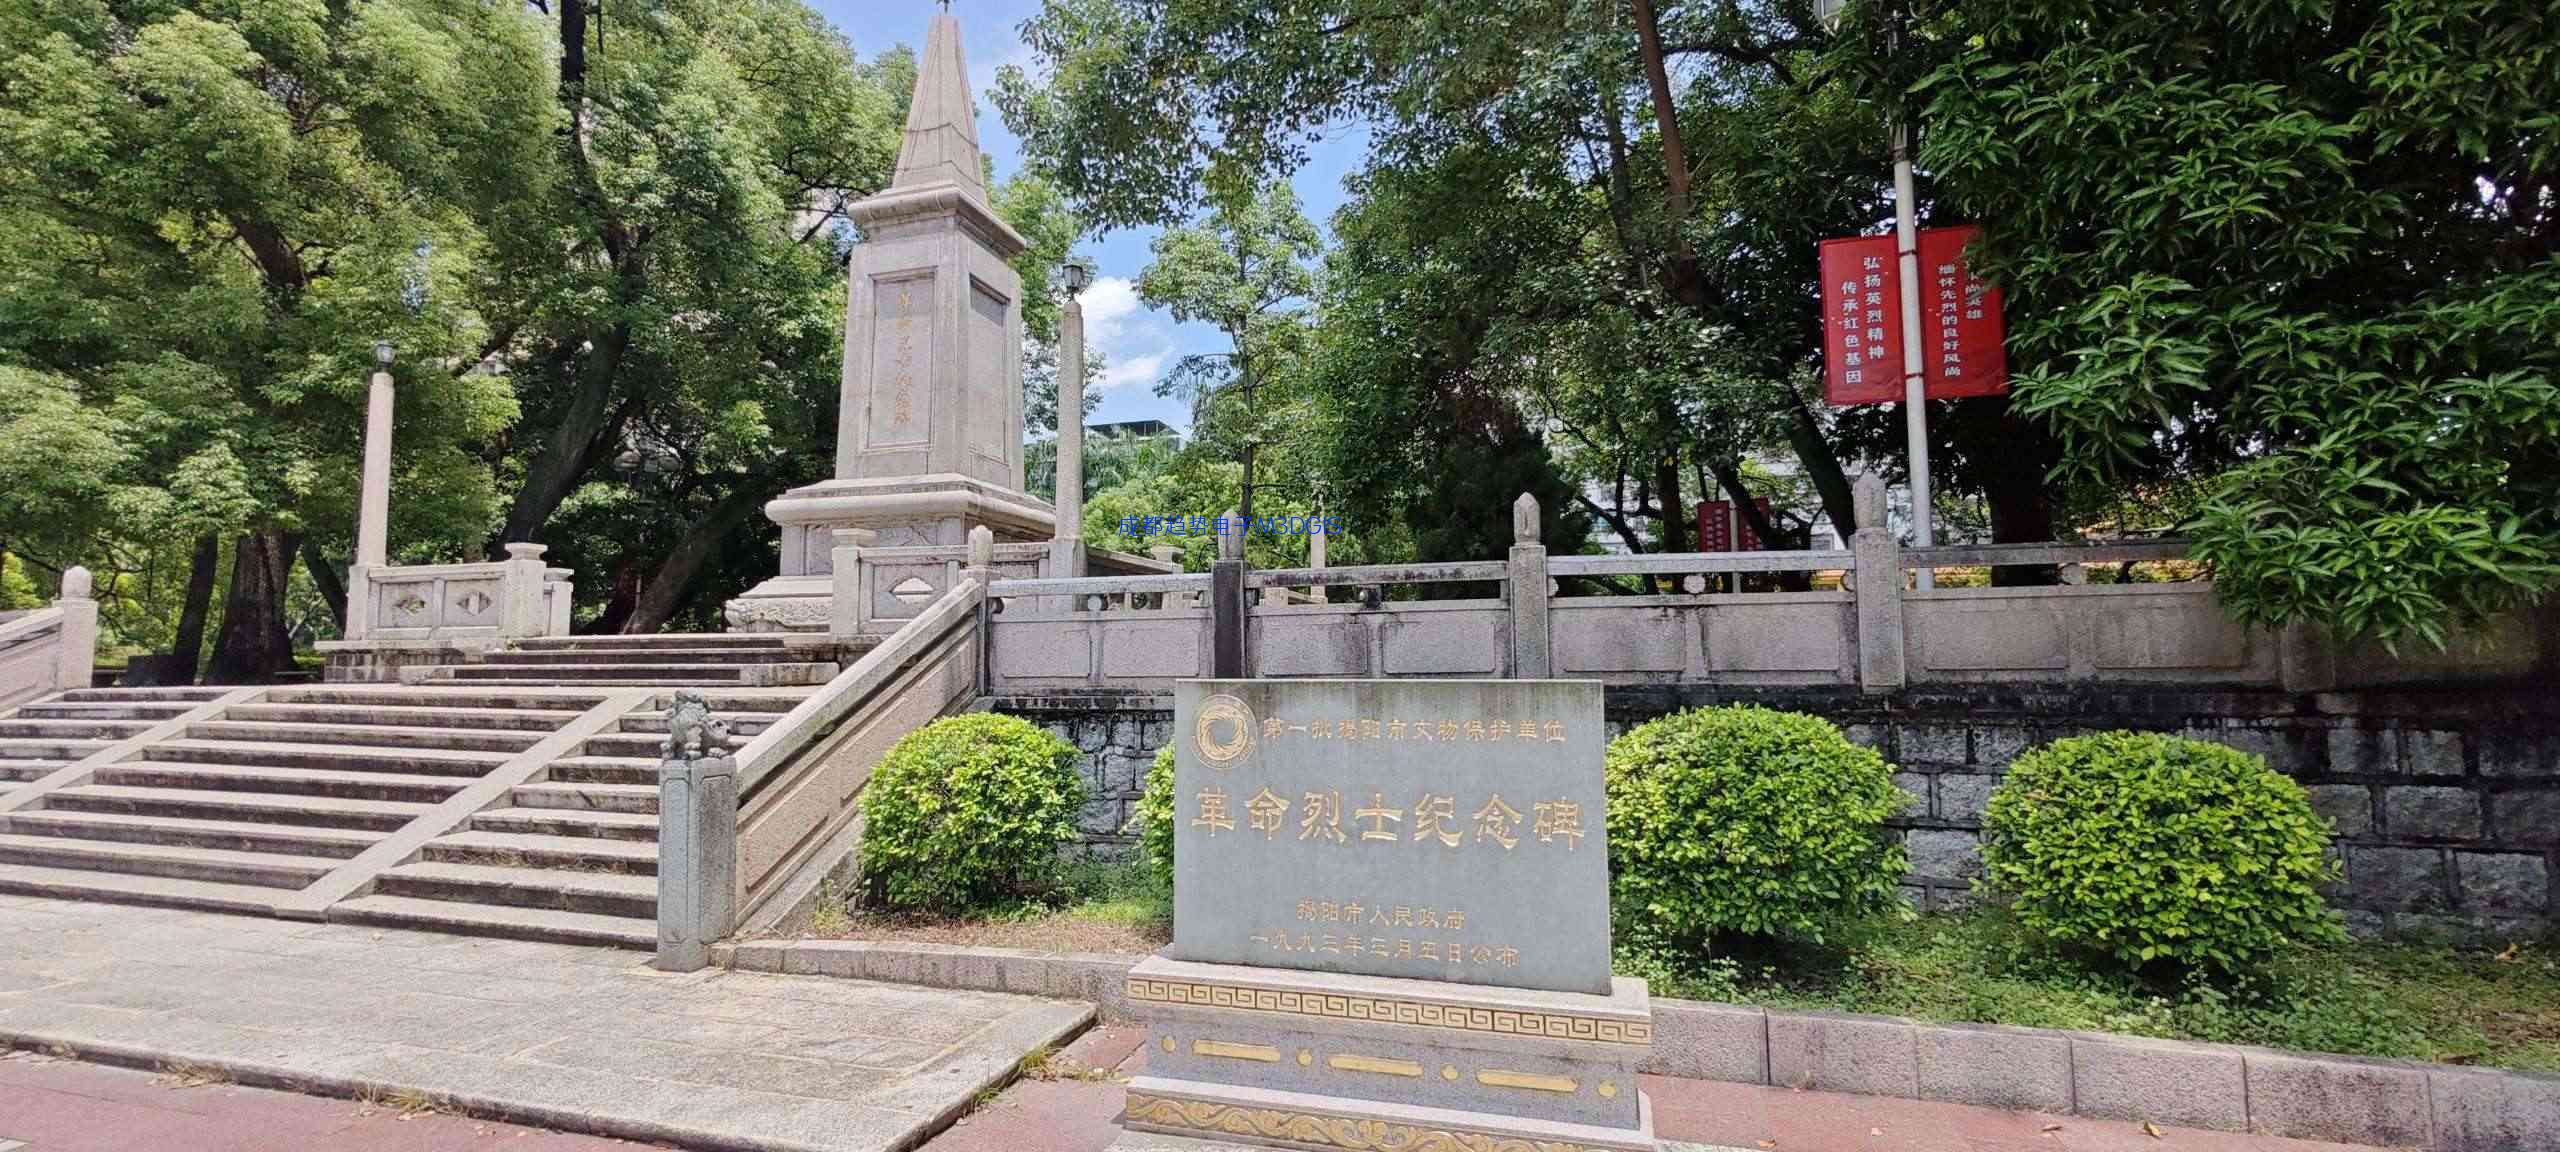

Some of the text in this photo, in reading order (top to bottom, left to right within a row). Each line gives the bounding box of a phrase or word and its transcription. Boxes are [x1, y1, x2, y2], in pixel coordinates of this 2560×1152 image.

[1841, 281, 1863, 384] 传承红色基因
[1863, 256, 1885, 360] 弘扬英烈精神
[1937, 264, 1961, 377] 缅怀先烈的良好风尚
[1263, 717, 1567, 743] 第一批揭阳市文物保护单位
[1191, 785, 1586, 851] 革命烈士纪念碑
[1296, 896, 1466, 930] 揭阳市人民政府
